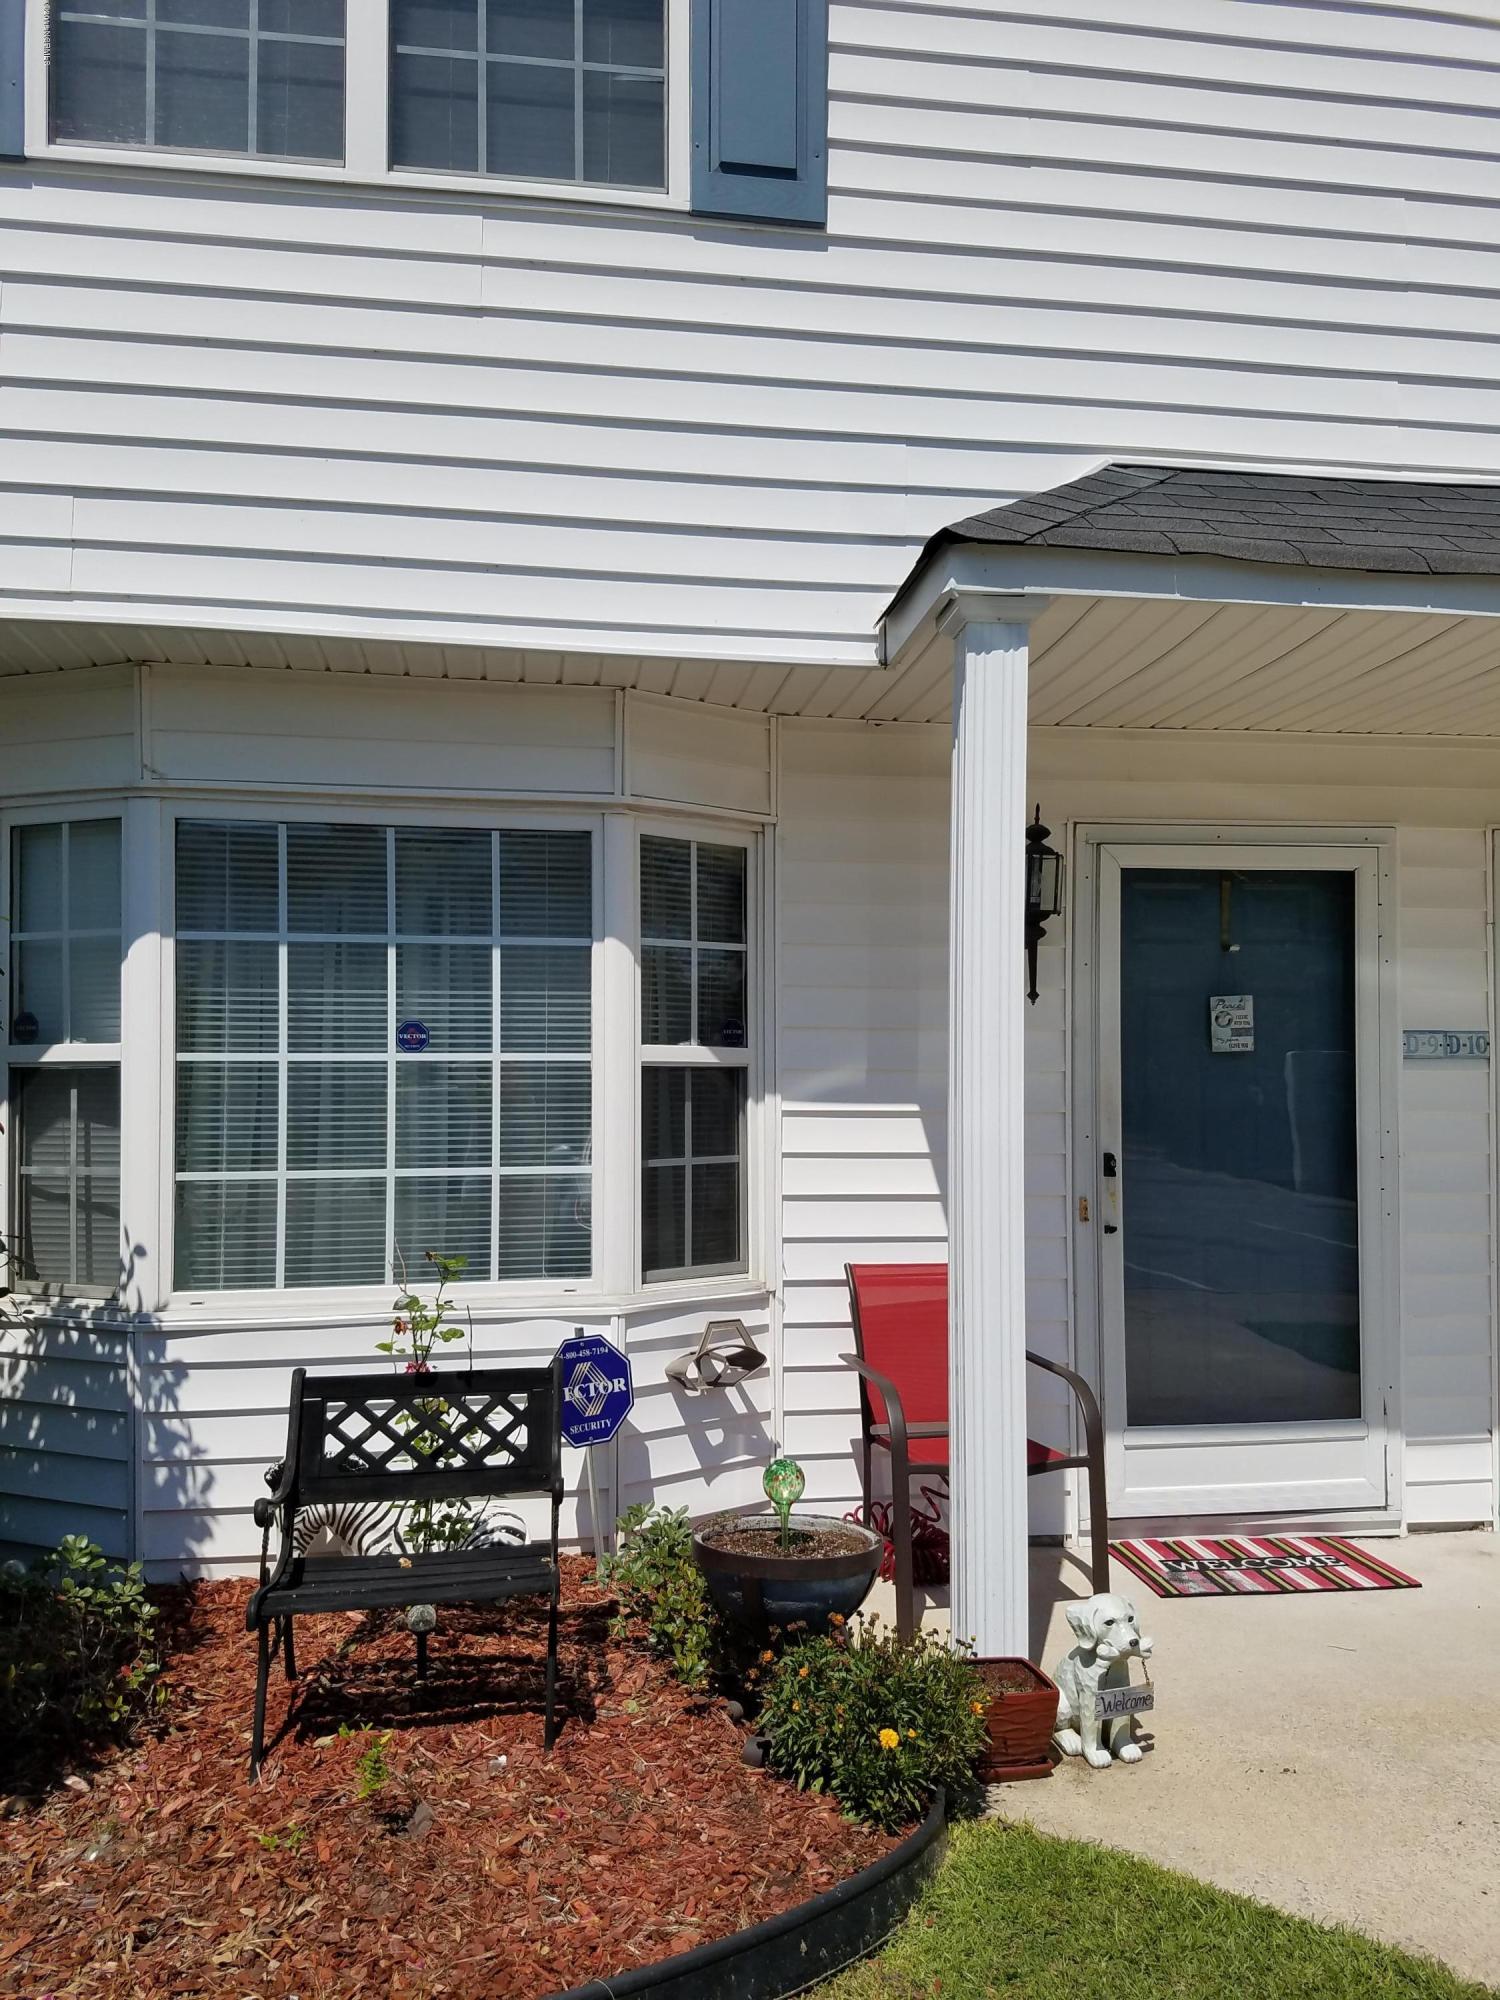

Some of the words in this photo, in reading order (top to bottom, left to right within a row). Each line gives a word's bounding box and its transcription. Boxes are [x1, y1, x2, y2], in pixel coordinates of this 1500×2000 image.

[1447, 1034, 1488, 1055] D-10
[562, 1377, 627, 1402] ECTOR
[569, 1418, 612, 1435] SECURITY
[1164, 1555, 1346, 1571] WELCOME
[1100, 1692, 1152, 1714] Welcome
